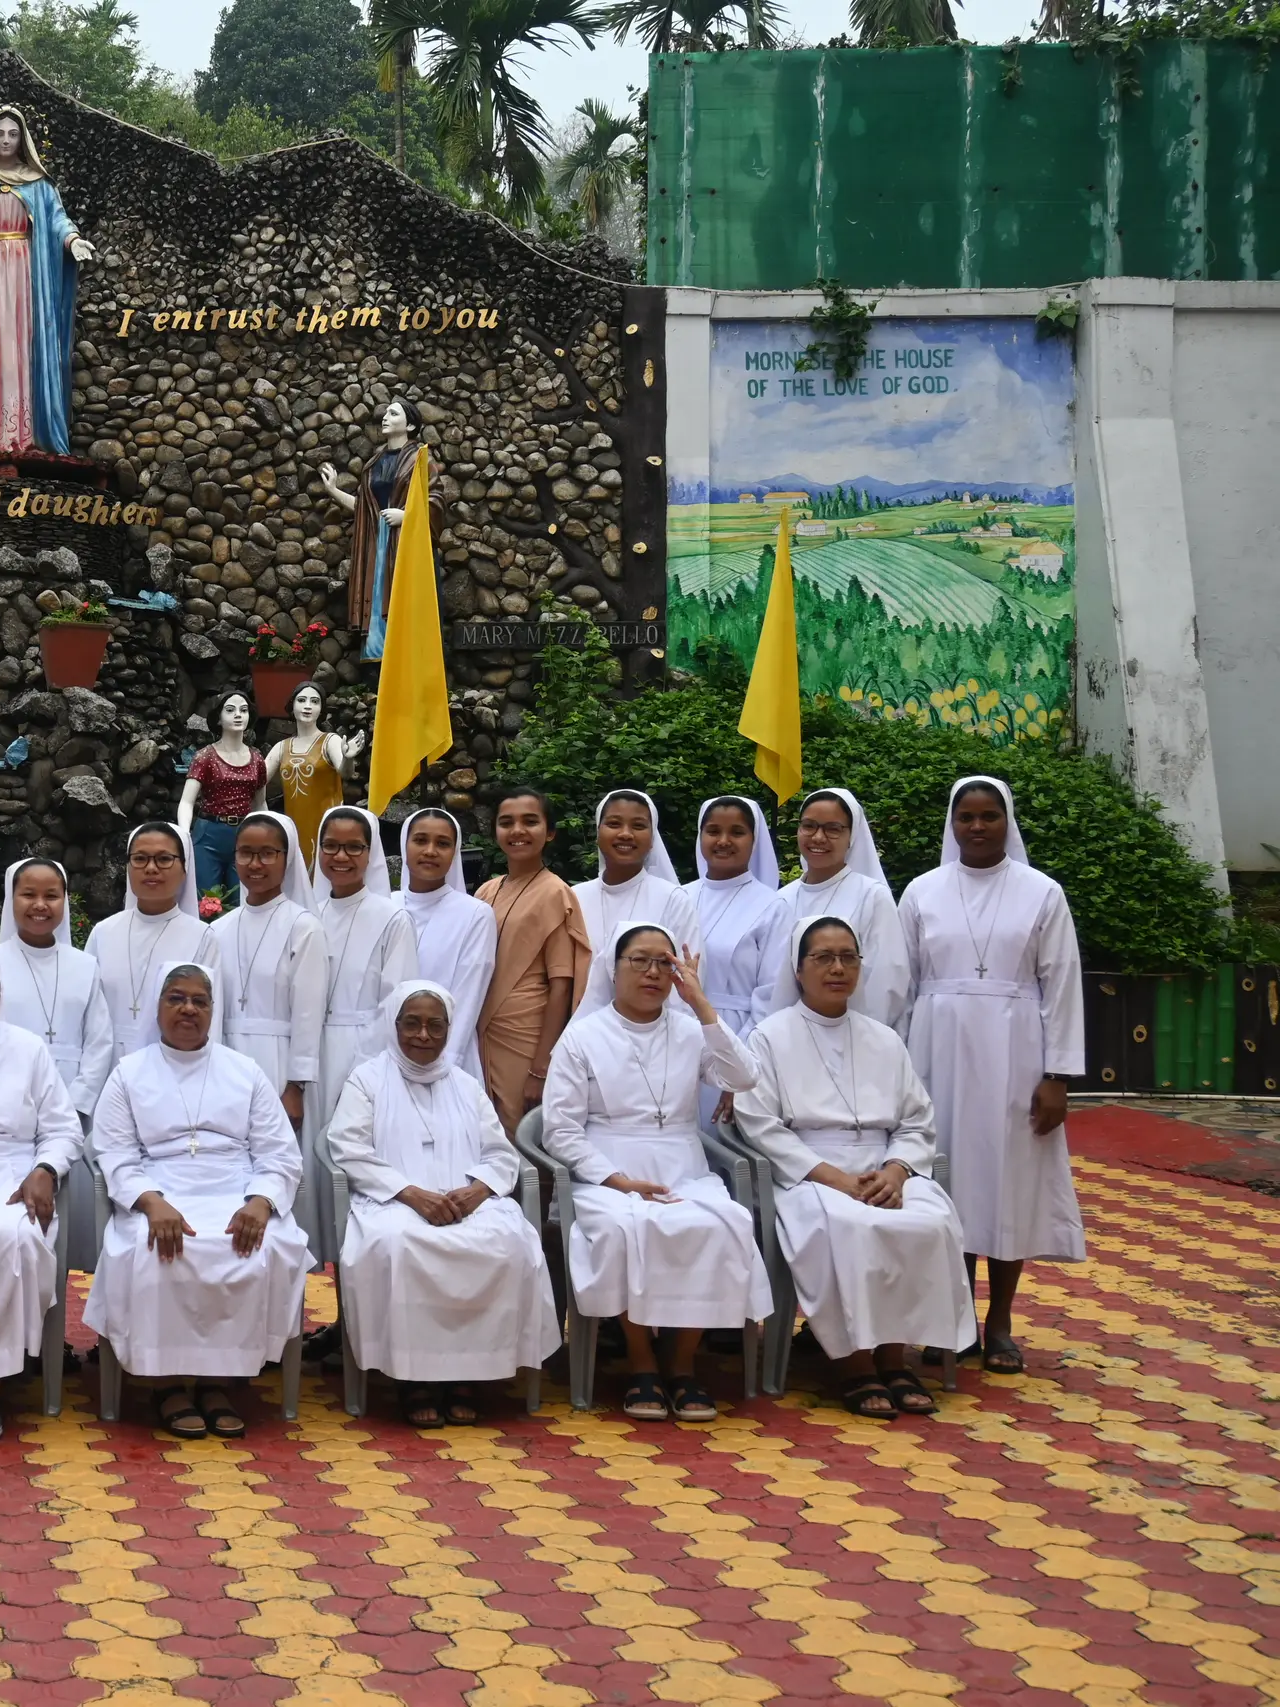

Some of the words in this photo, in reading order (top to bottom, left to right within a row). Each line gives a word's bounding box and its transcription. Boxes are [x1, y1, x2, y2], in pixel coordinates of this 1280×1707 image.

[117, 308, 135, 337] I
[153, 304, 278, 333] entrust
[296, 304, 381, 334] them
[398, 306, 429, 332] to
[433, 306, 499, 335] you
[895, 348, 955, 369] HOUSE
[747, 379, 769, 398] OF
[778, 379, 816, 397] THE
[823, 377, 869, 396] LOVE
[882, 376, 903, 395] OF
[7, 487, 160, 527] daughters
[461, 625, 518, 646] MARY
